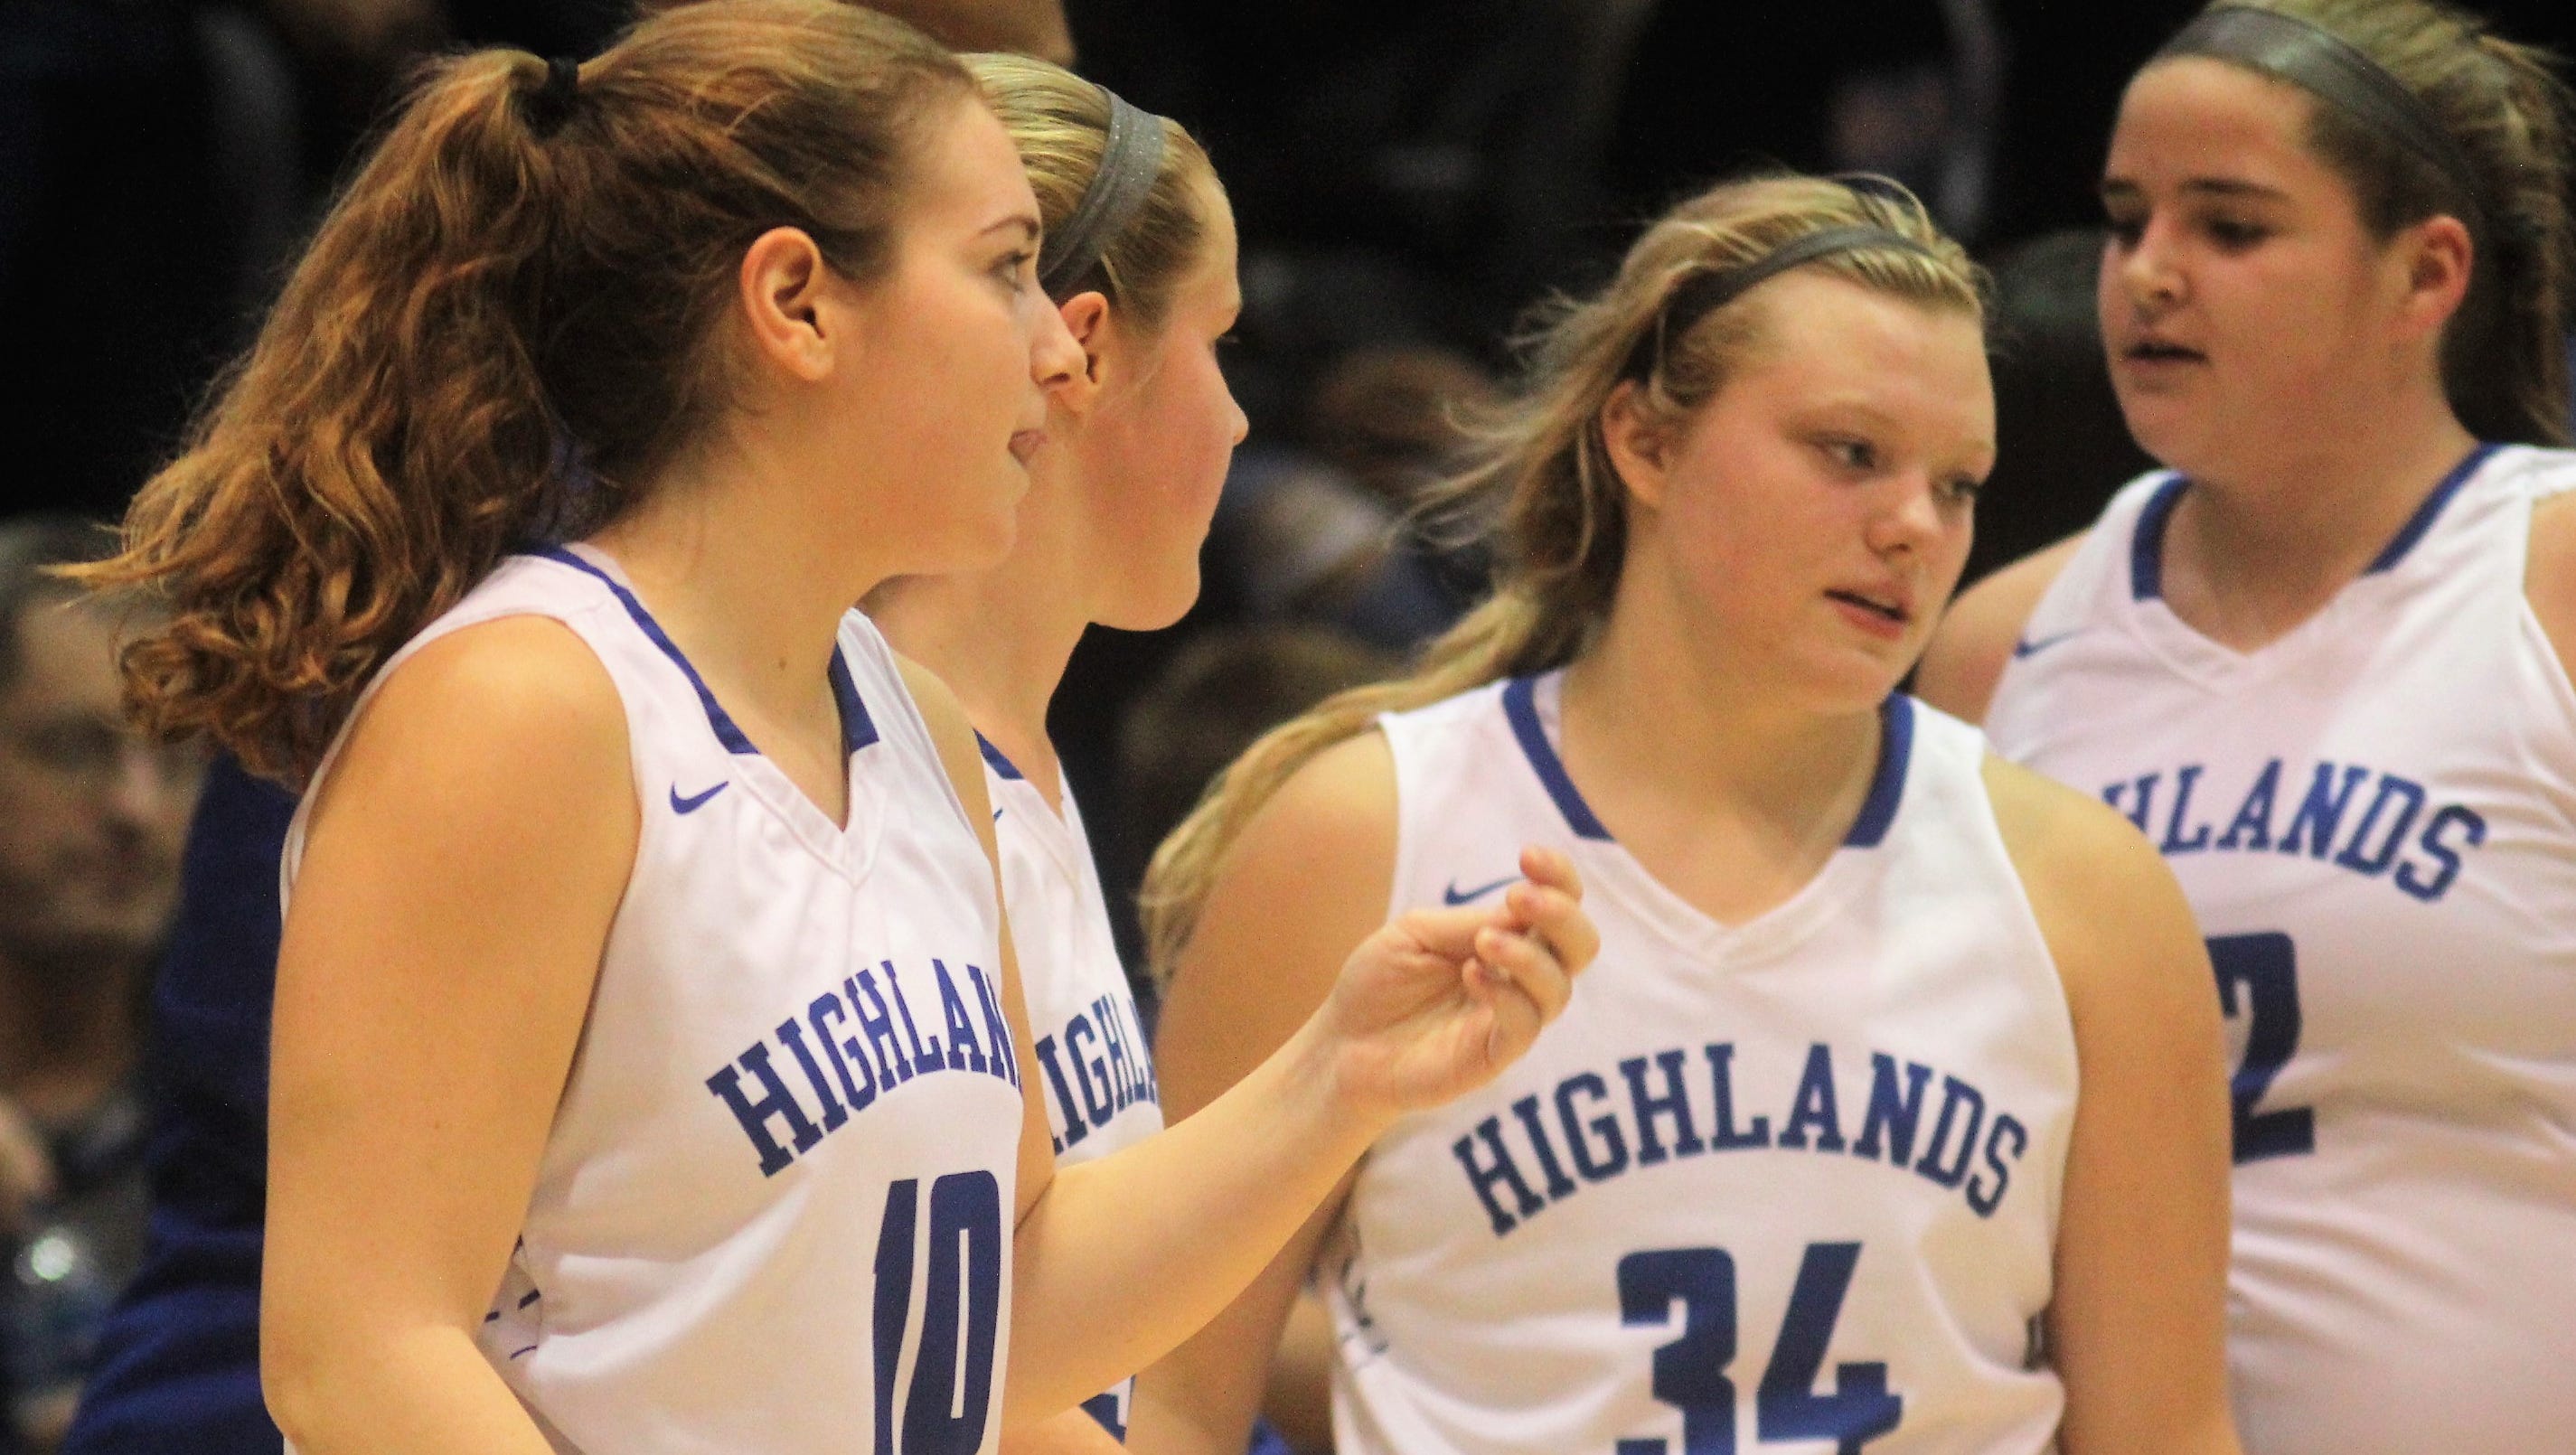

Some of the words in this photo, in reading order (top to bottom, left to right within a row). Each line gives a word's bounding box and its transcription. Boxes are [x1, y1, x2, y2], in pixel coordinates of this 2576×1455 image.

[705, 958, 1023, 1177] HIGHLAN
[1453, 1043, 2027, 1237] HIGHLANDS
[873, 1169, 1001, 1455] 10
[1617, 1241, 1903, 1455] 34
